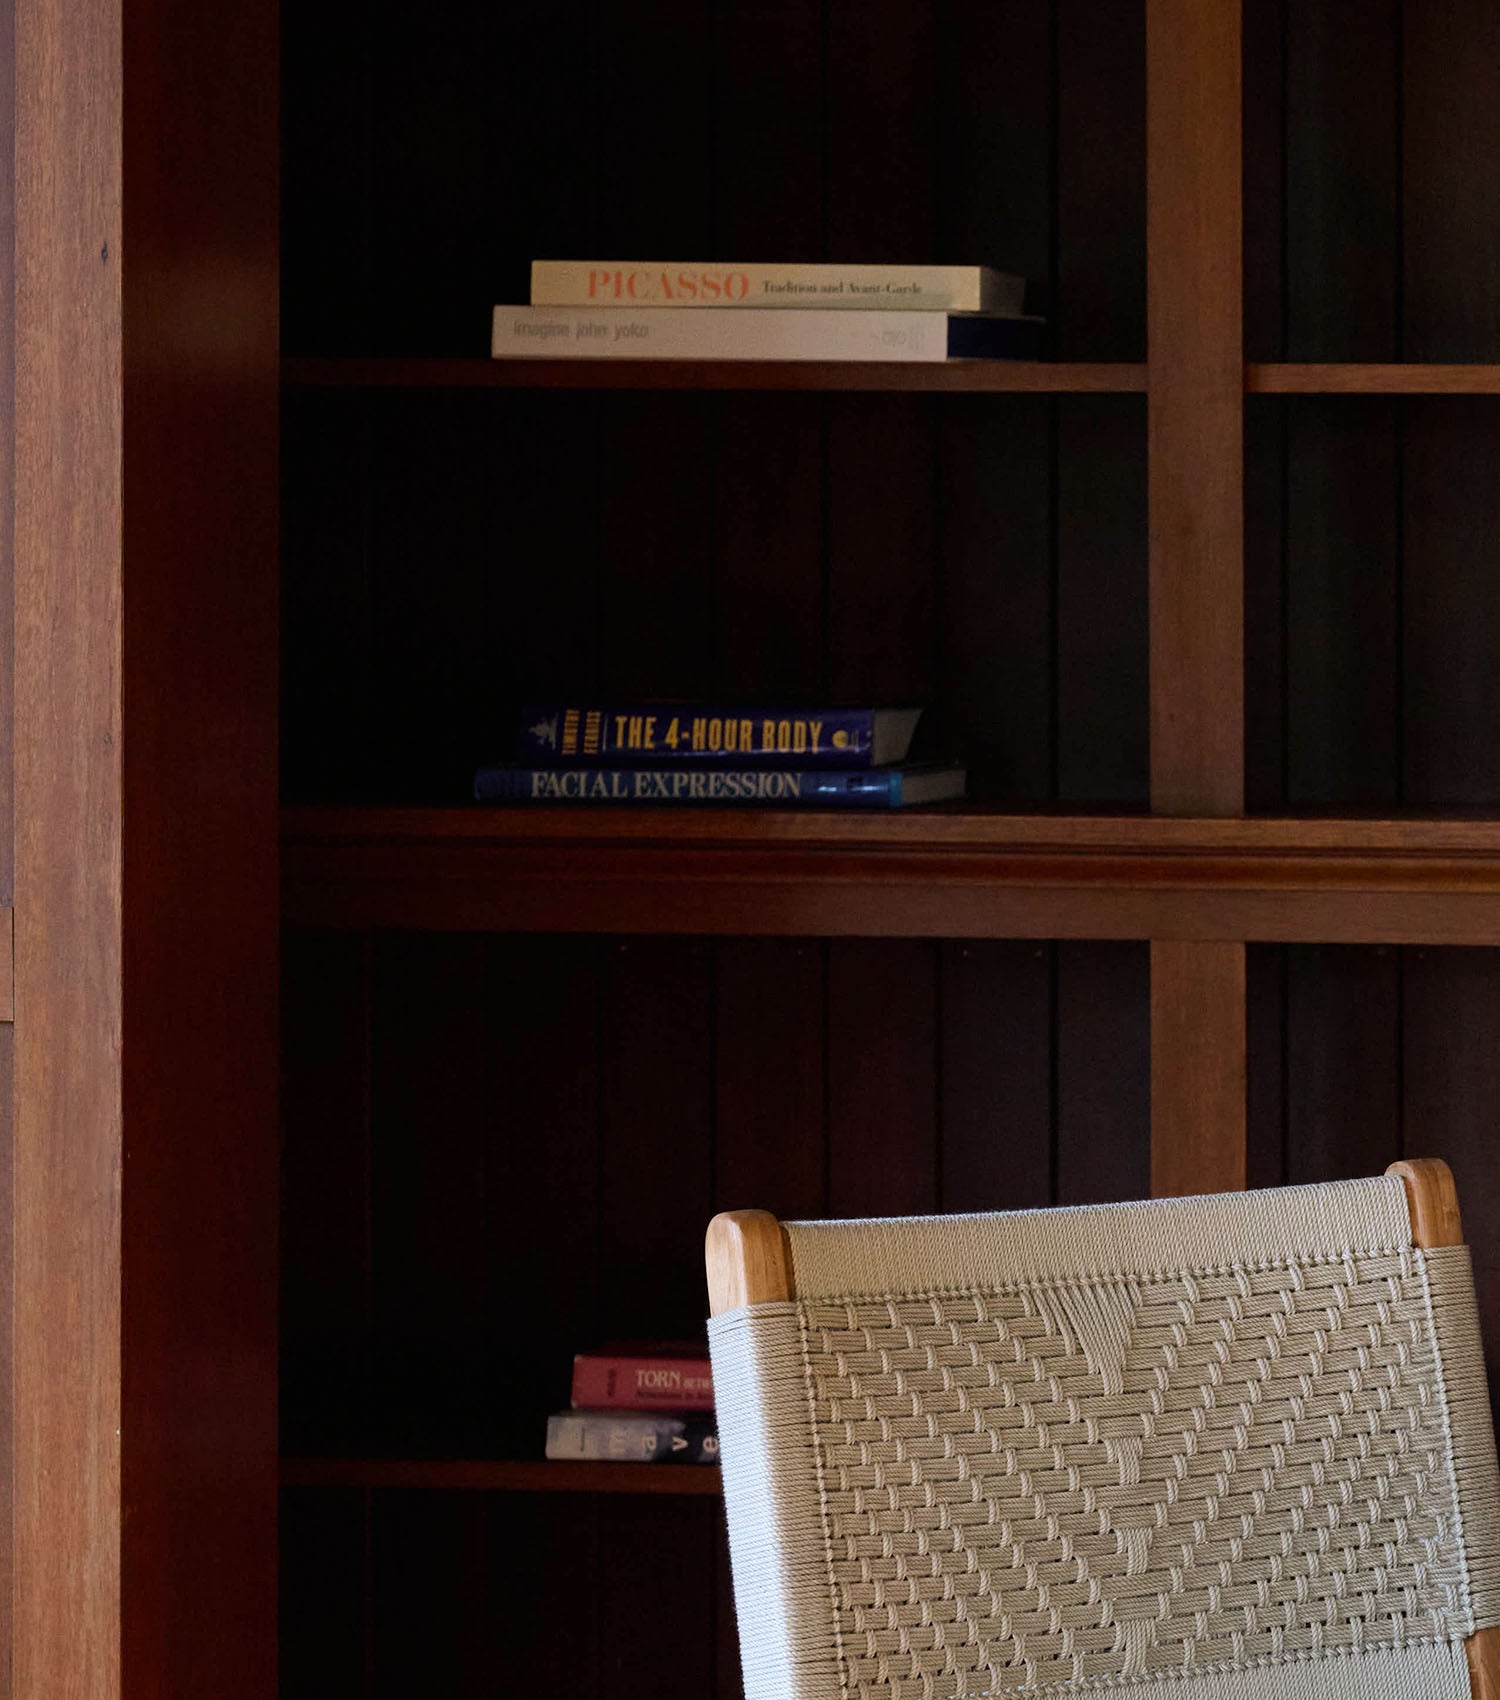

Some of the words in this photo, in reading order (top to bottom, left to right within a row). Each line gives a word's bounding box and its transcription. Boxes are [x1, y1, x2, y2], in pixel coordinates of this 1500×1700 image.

[587, 270, 750, 301] PICASSO
[762, 280, 817, 294] Tradition
[820, 281, 844, 294] and
[612, 322, 650, 342] yoko
[614, 715, 657, 749] THE
[664, 716, 753, 752] 4-HOUR
[762, 719, 824, 754] BODY
[530, 771, 629, 799] FACIAL
[632, 771, 803, 799] EXPRESSION
[634, 1369, 681, 1390] TORN
